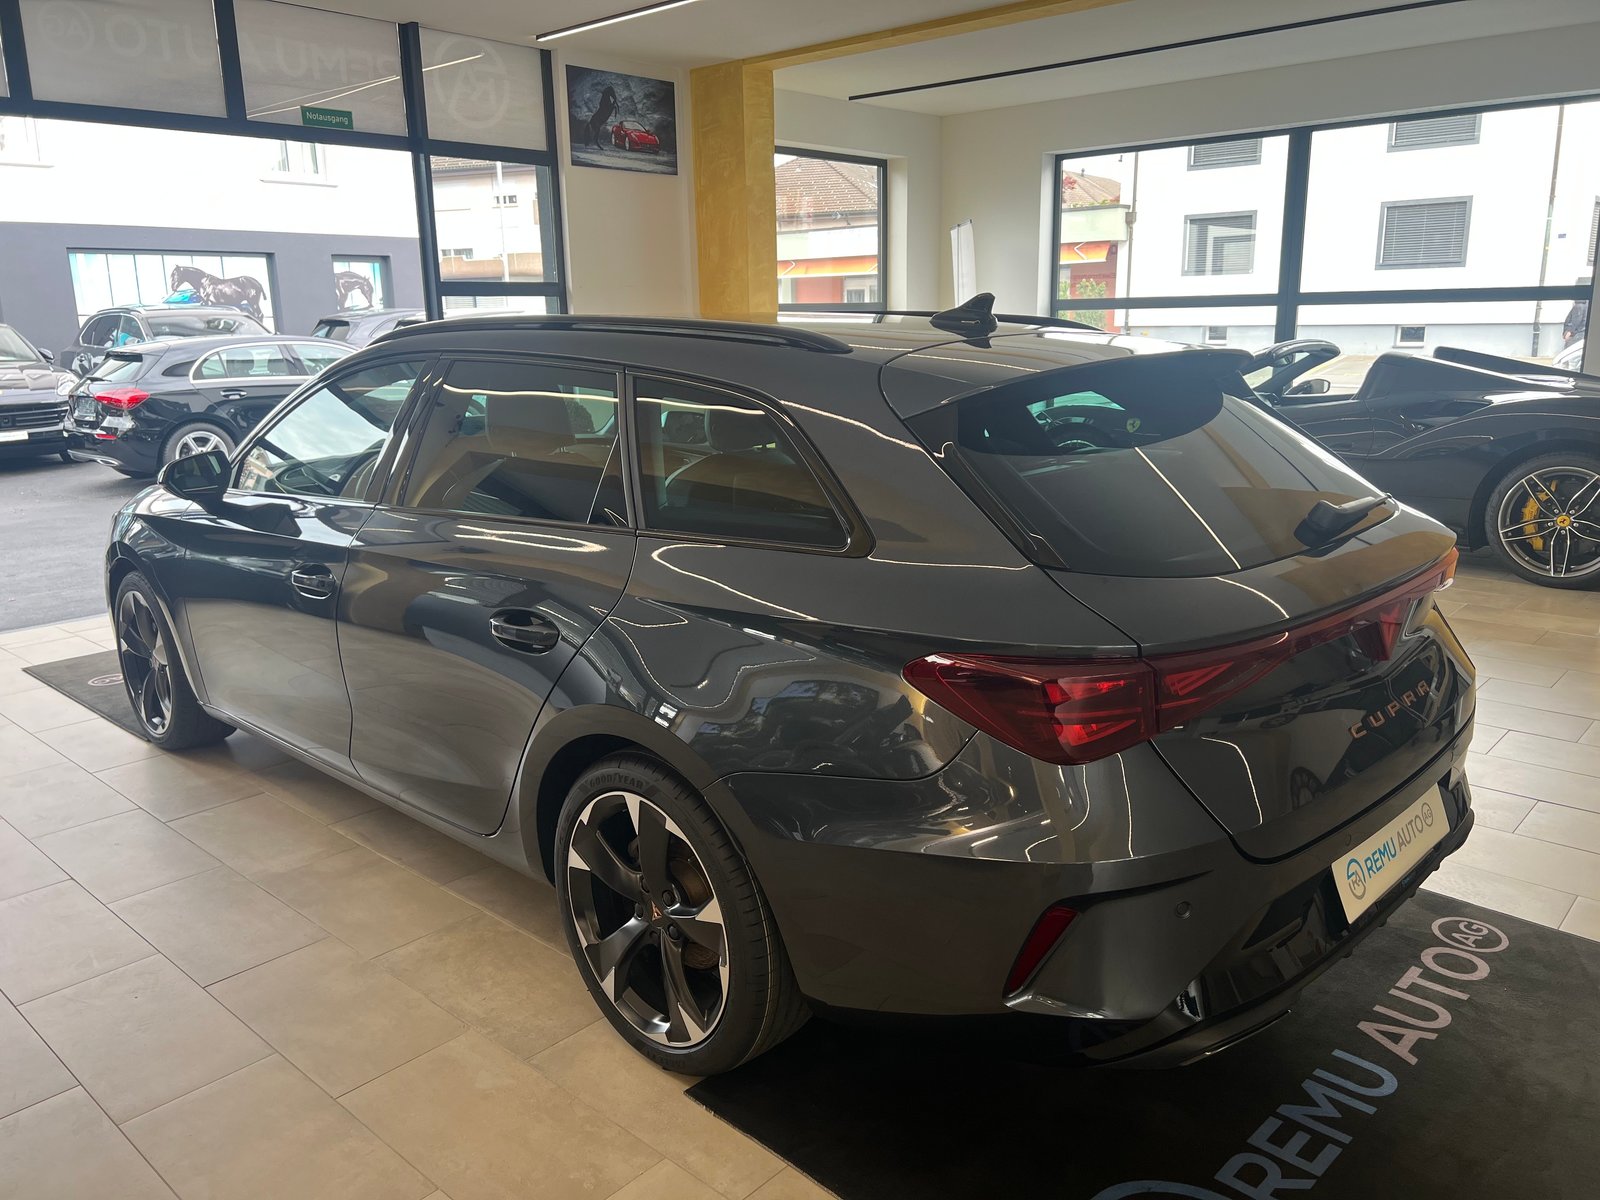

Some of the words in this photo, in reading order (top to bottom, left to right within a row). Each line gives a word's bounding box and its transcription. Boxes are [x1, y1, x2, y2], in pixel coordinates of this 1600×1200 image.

[306, 111, 349, 125] Notausgang
[1350, 680, 1430, 739] CUPRA
[1364, 837, 1397, 879] REMU
[1396, 814, 1424, 852] AUTO
[1213, 1048, 1399, 1200] REMU
[1356, 946, 1491, 1066] AUTO
